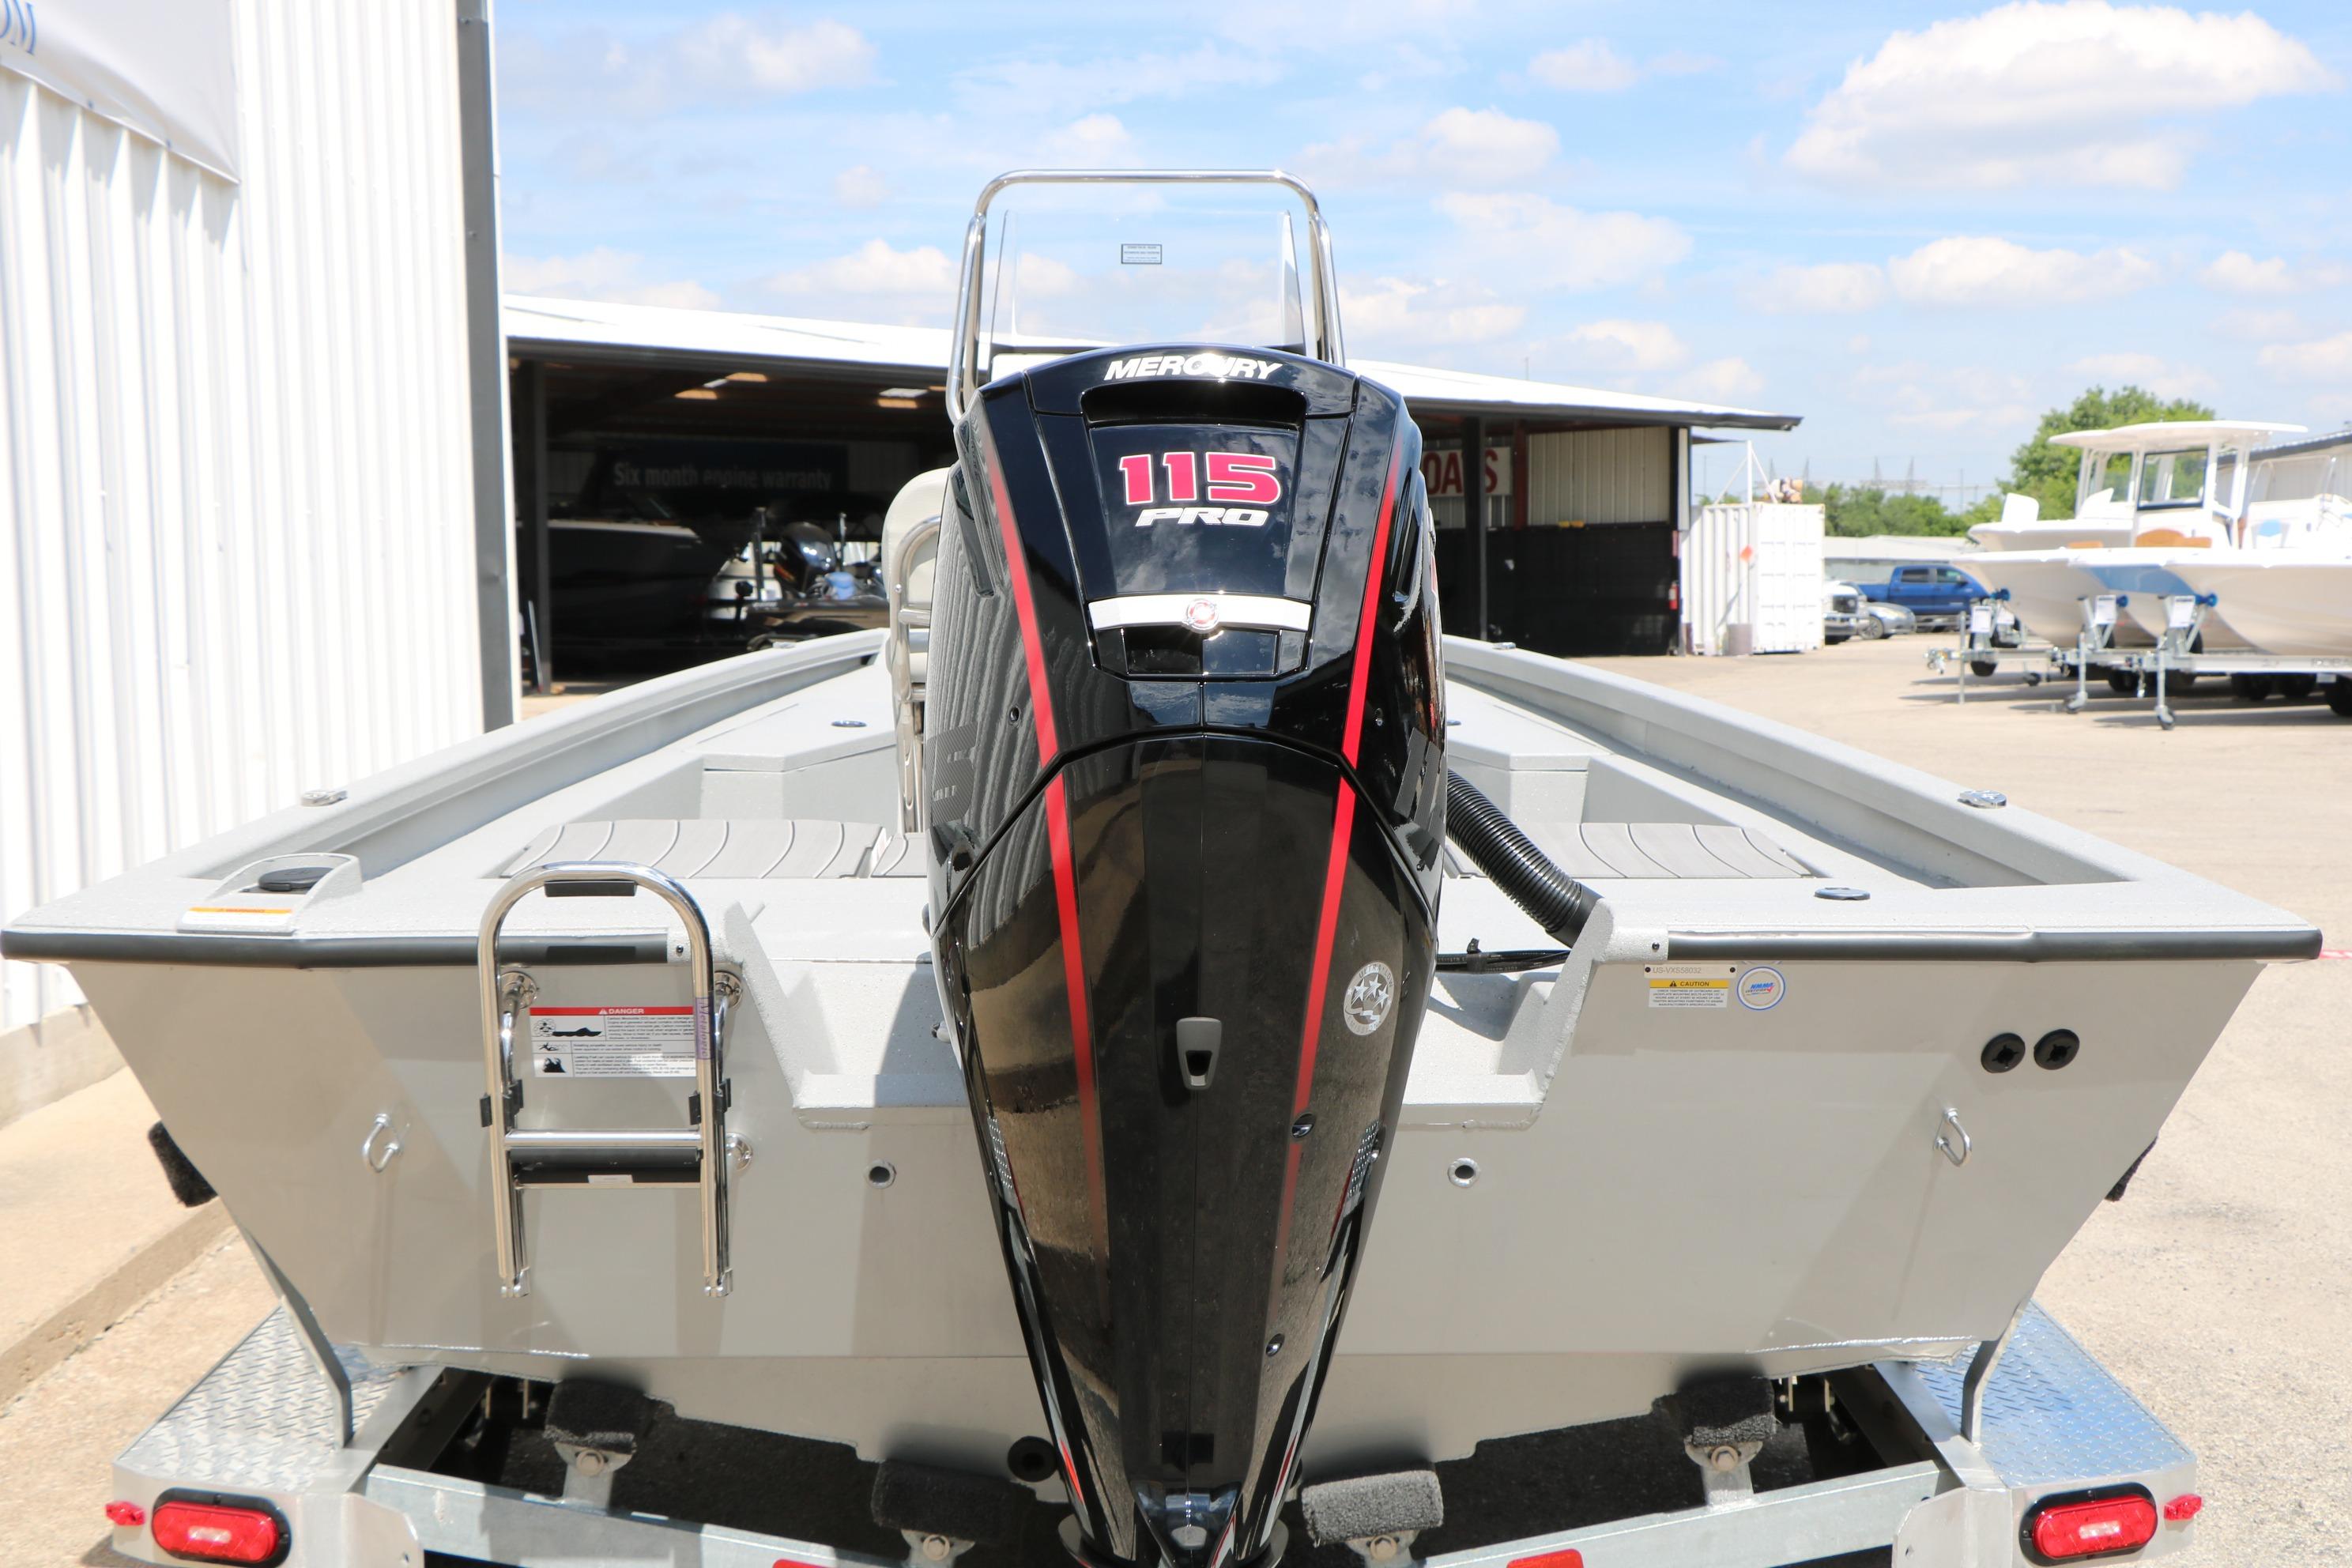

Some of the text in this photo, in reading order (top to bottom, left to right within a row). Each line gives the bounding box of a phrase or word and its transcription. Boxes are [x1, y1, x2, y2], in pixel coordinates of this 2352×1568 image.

[1104, 353, 1283, 381] MERCURY
[613, 462, 833, 492] Six month engine warranty
[1119, 451, 1281, 505] 115
[1135, 507, 1269, 527] PRO
